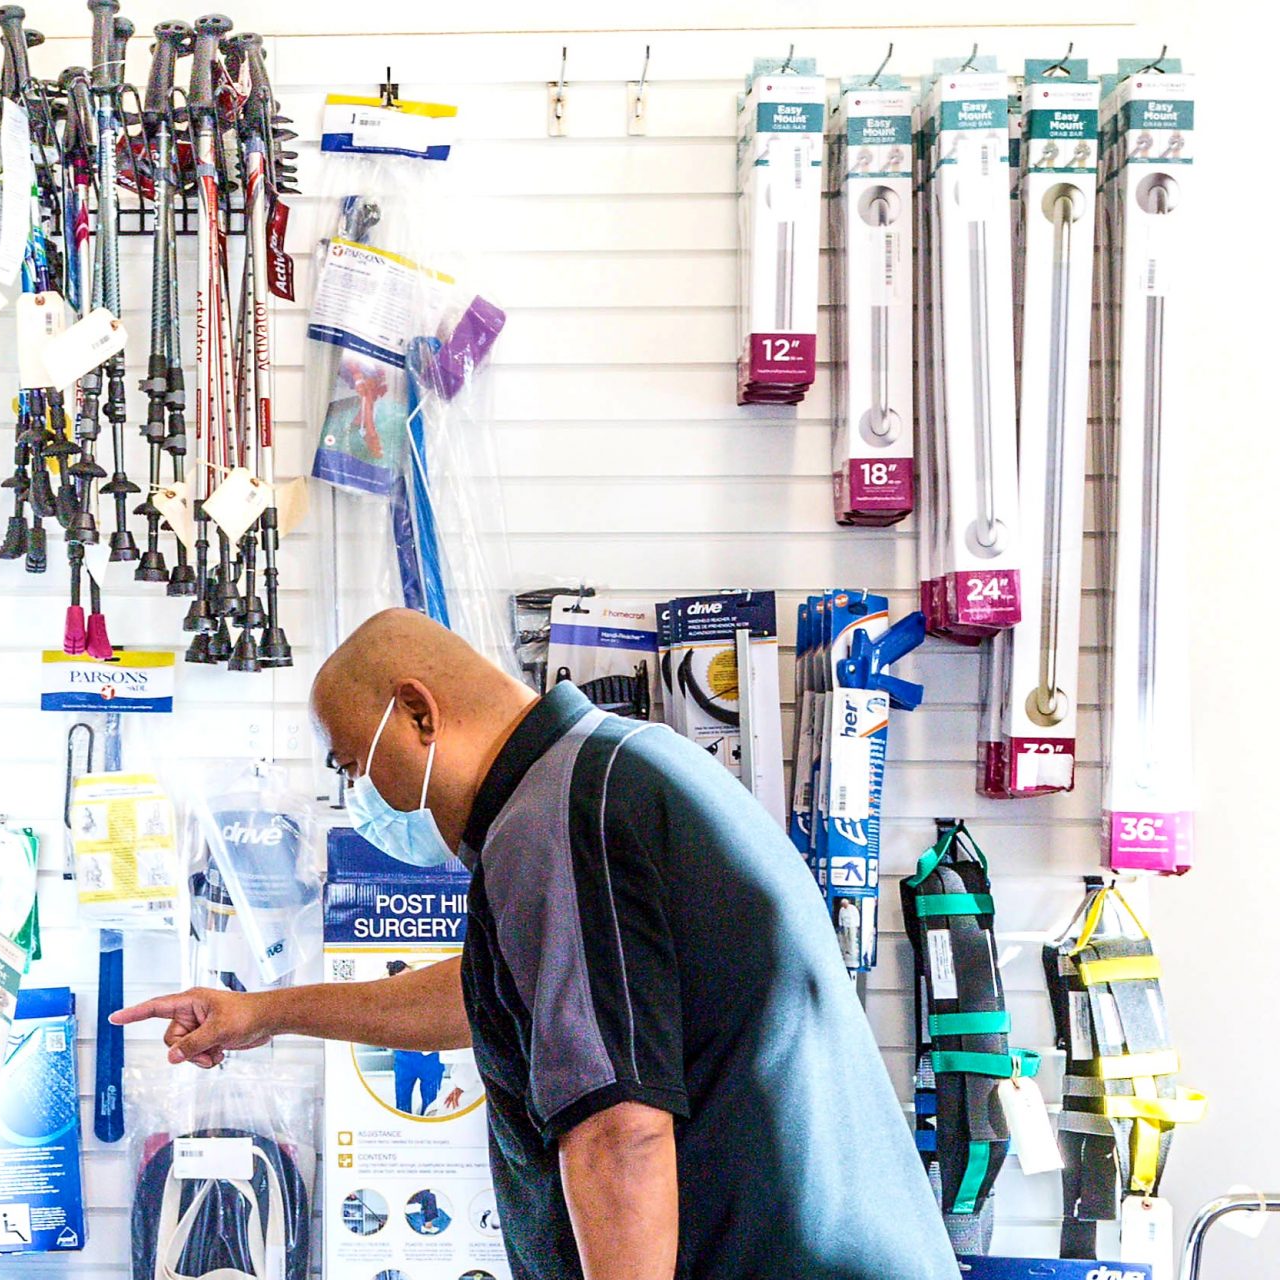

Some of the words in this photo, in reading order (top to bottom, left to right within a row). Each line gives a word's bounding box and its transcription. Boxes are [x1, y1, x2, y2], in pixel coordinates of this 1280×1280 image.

[777, 105, 802, 116] Easy
[962, 103, 987, 113] Easy
[1148, 103, 1174, 113] Easy
[1054, 112, 1080, 123] Easy
[866, 119, 891, 129] Easy
[343, 247, 386, 265] PARSONS
[256, 300, 270, 371] Activator
[687, 601, 723, 615] drive
[608, 609, 645, 620] homecraft
[70, 671, 148, 683] PARSONS
[223, 821, 283, 846] drive
[376, 894, 436, 914] POST
[353, 918, 462, 938] SURGERY
[358, 1130, 402, 1138] ASSISTANCE
[358, 1153, 397, 1161] CONTENTS
